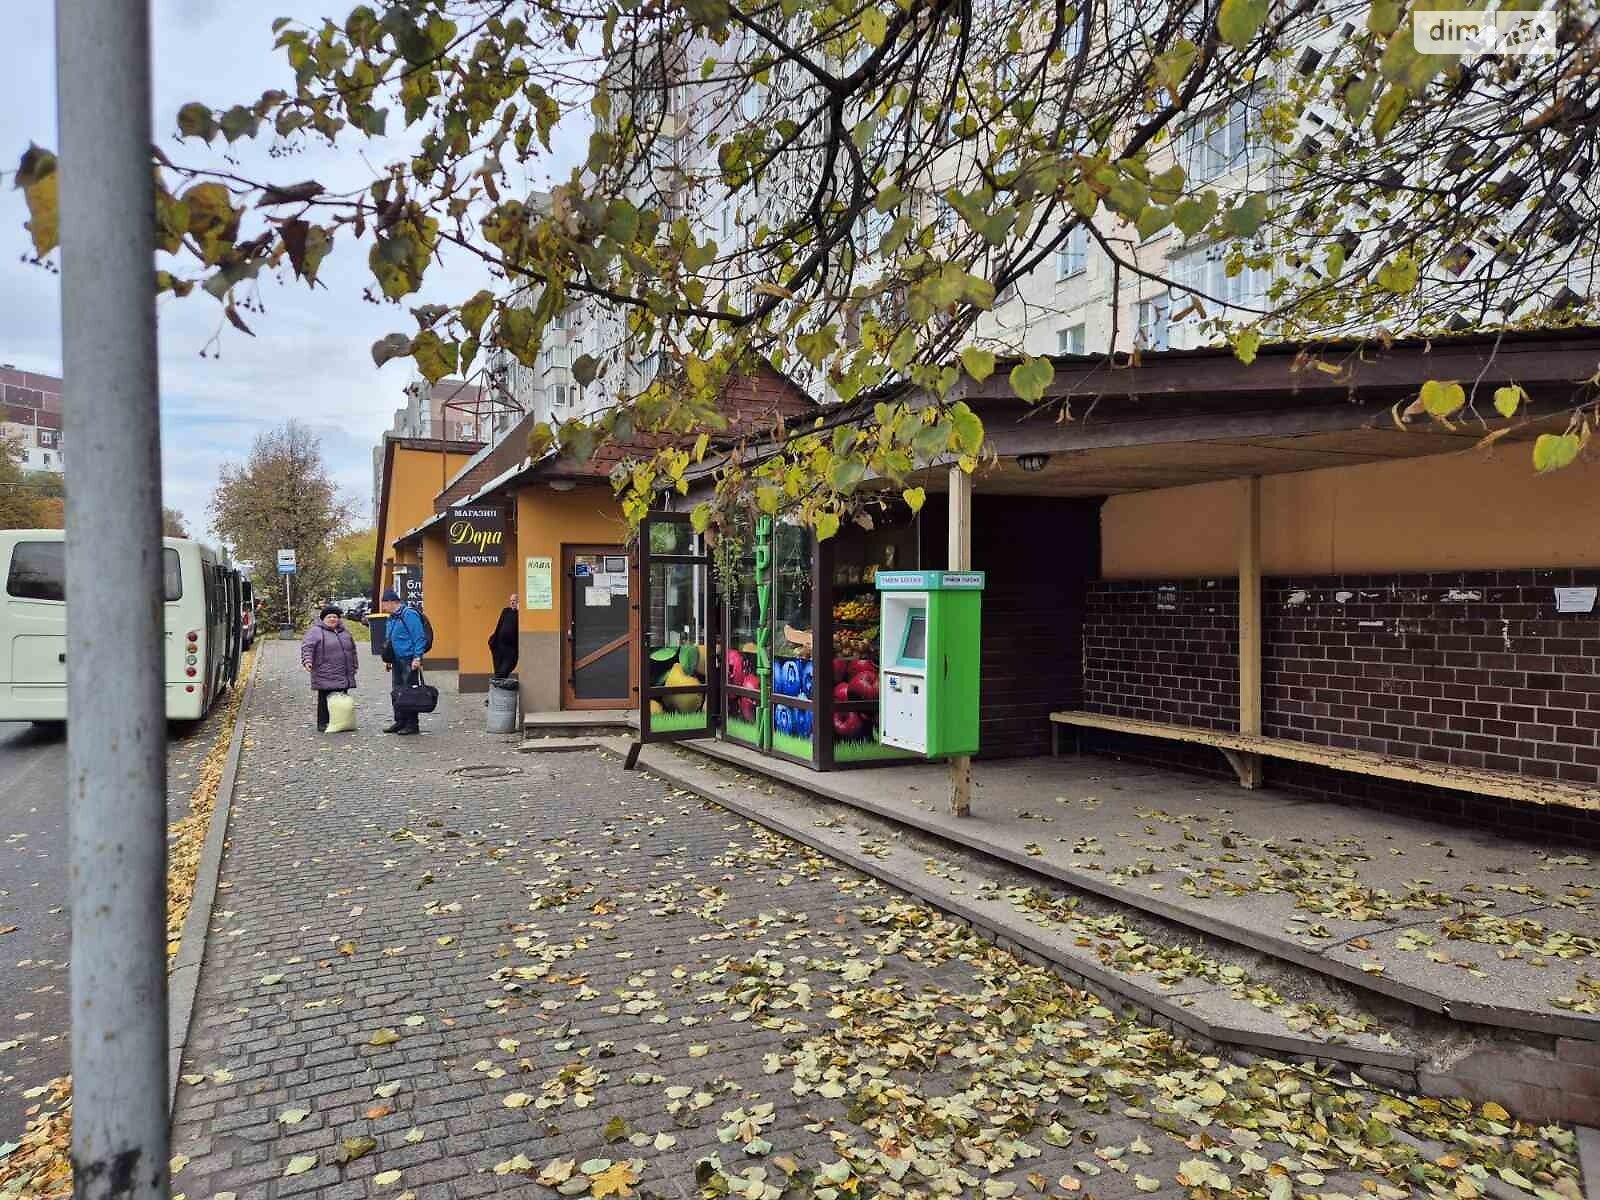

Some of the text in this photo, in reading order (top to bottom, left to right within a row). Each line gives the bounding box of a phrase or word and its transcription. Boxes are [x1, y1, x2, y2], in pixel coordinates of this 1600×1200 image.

[449, 520, 503, 553] Дора
[455, 555, 499, 564] ПРОДУКТИ
[407, 579, 424, 590] бл
